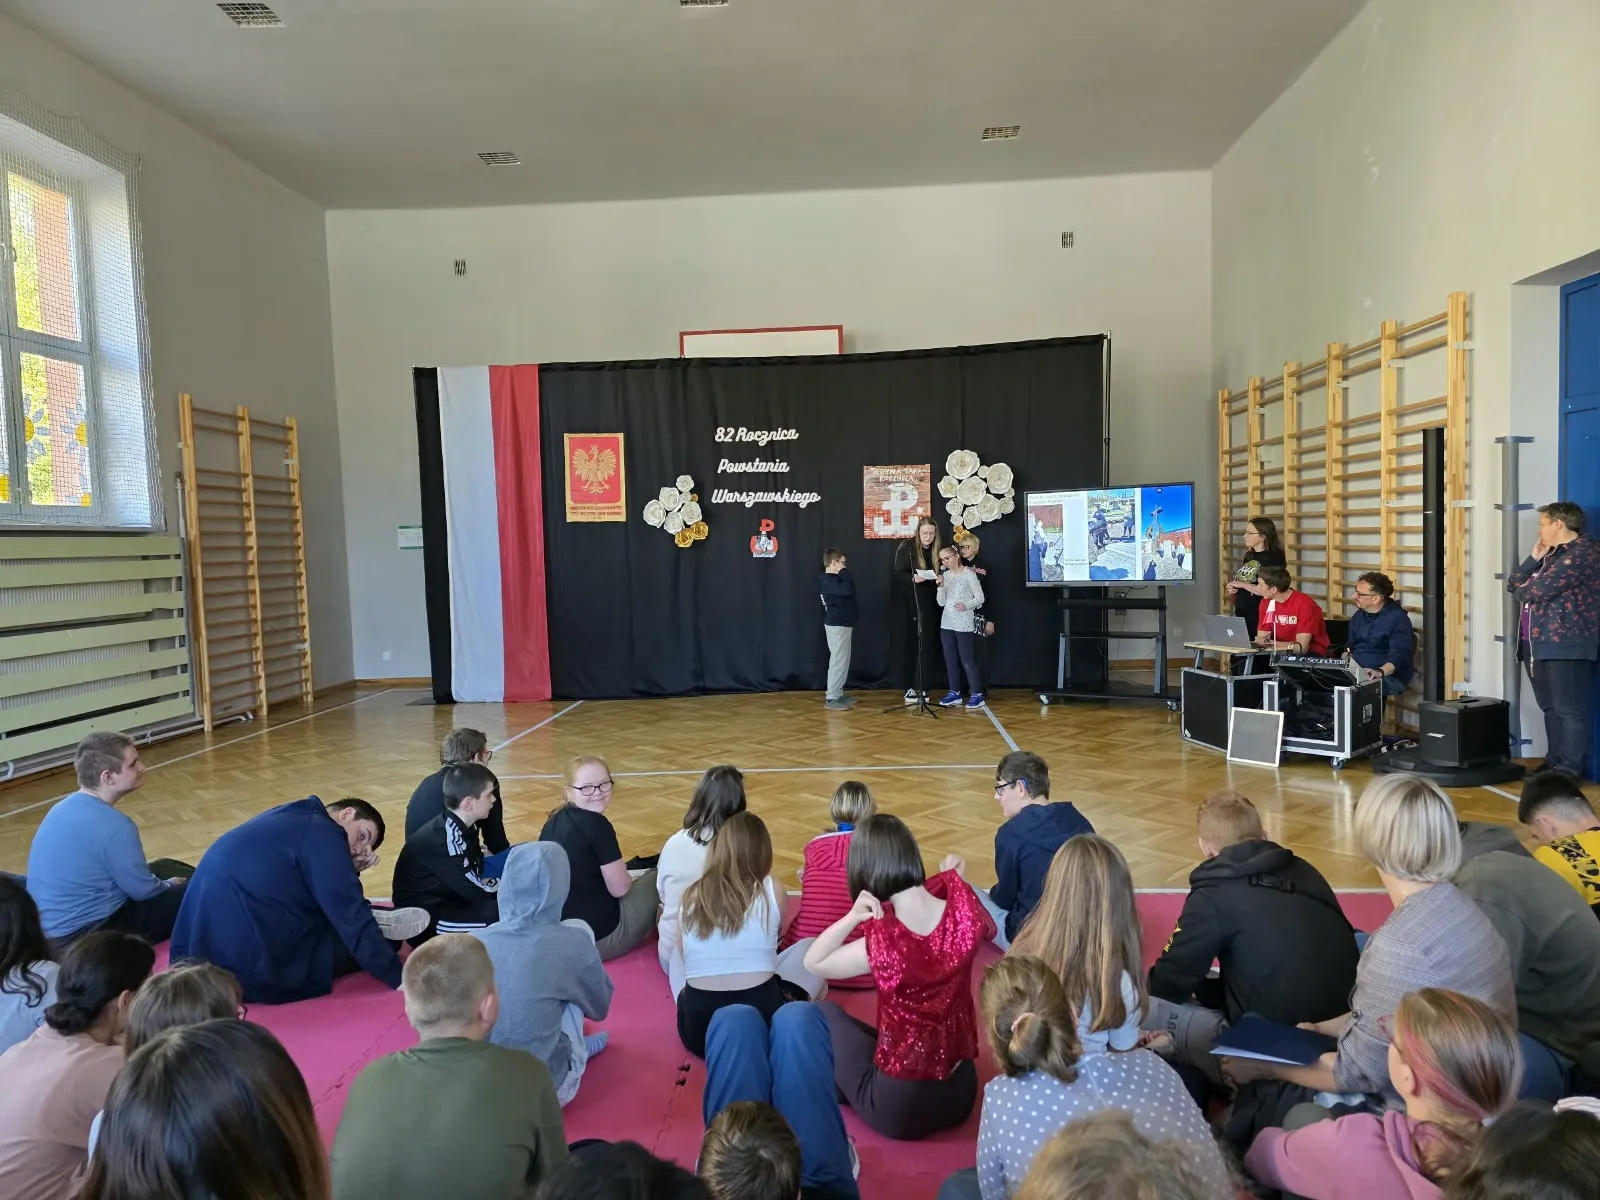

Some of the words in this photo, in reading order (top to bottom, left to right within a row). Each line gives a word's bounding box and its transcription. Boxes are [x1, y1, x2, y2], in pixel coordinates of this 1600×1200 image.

[714, 427, 735, 442] 82
[735, 427, 799, 446] Rocznica
[717, 458, 790, 473] Powstania
[711, 488, 821, 508] Warszawskiego
